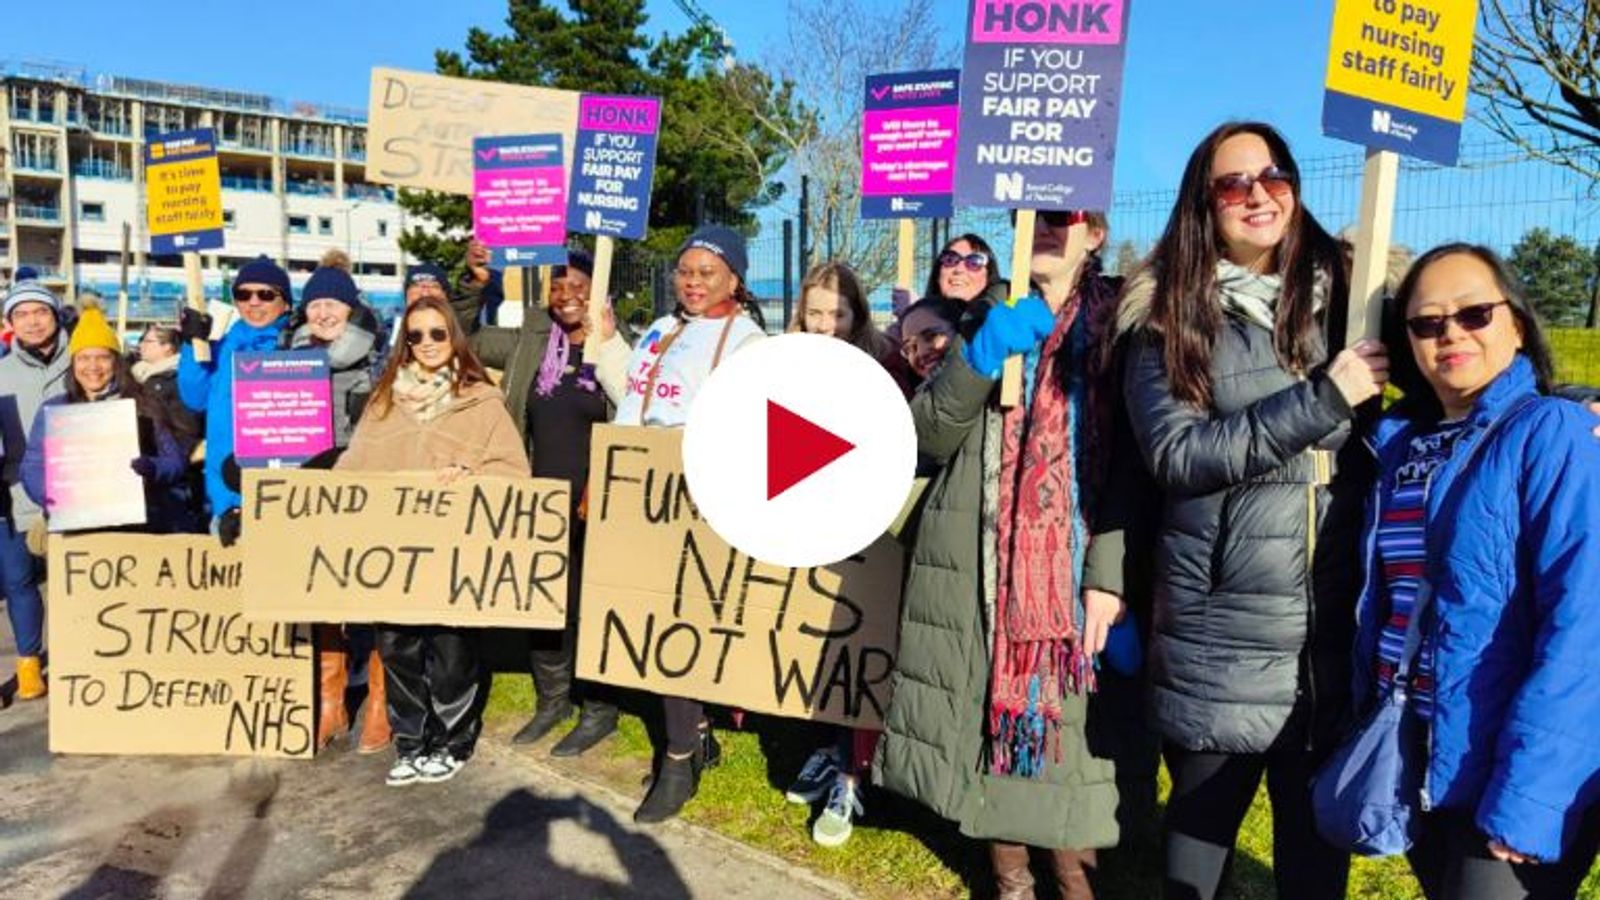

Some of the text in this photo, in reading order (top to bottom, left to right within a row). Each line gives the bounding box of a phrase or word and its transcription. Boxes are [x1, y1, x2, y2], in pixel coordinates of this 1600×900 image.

[983, 2, 1112, 34] HONK
[1400, 2, 1441, 33] pay
[1361, 22, 1445, 67] nursing
[1003, 47, 1084, 70] IF YOU
[983, 72, 1101, 94] SUPPORT
[1342, 49, 1456, 101] staff fairly
[588, 105, 648, 126] HONK
[982, 96, 1097, 118] FAIR PAY
[594, 133, 637, 149] IF YOU
[1010, 120, 1063, 141] FOR
[583, 147, 645, 164] SUPPORT
[977, 143, 1093, 167] NURSING
[582, 162, 643, 180] FAIR PAY
[595, 179, 624, 194] FOR
[577, 191, 639, 212] NURSING
[656, 383, 681, 399] OF
[254, 478, 568, 542] FUND THE NHS
[64, 550, 137, 597] FOR
[156, 556, 177, 588] A
[306, 544, 567, 614] NOT WAR
[673, 528, 866, 639] NHS
[94, 601, 310, 660] STRUGGLE
[599, 607, 893, 720] NOT WAR
[58, 669, 297, 711] TO DEFEND THE
[225, 700, 310, 756] NHS
